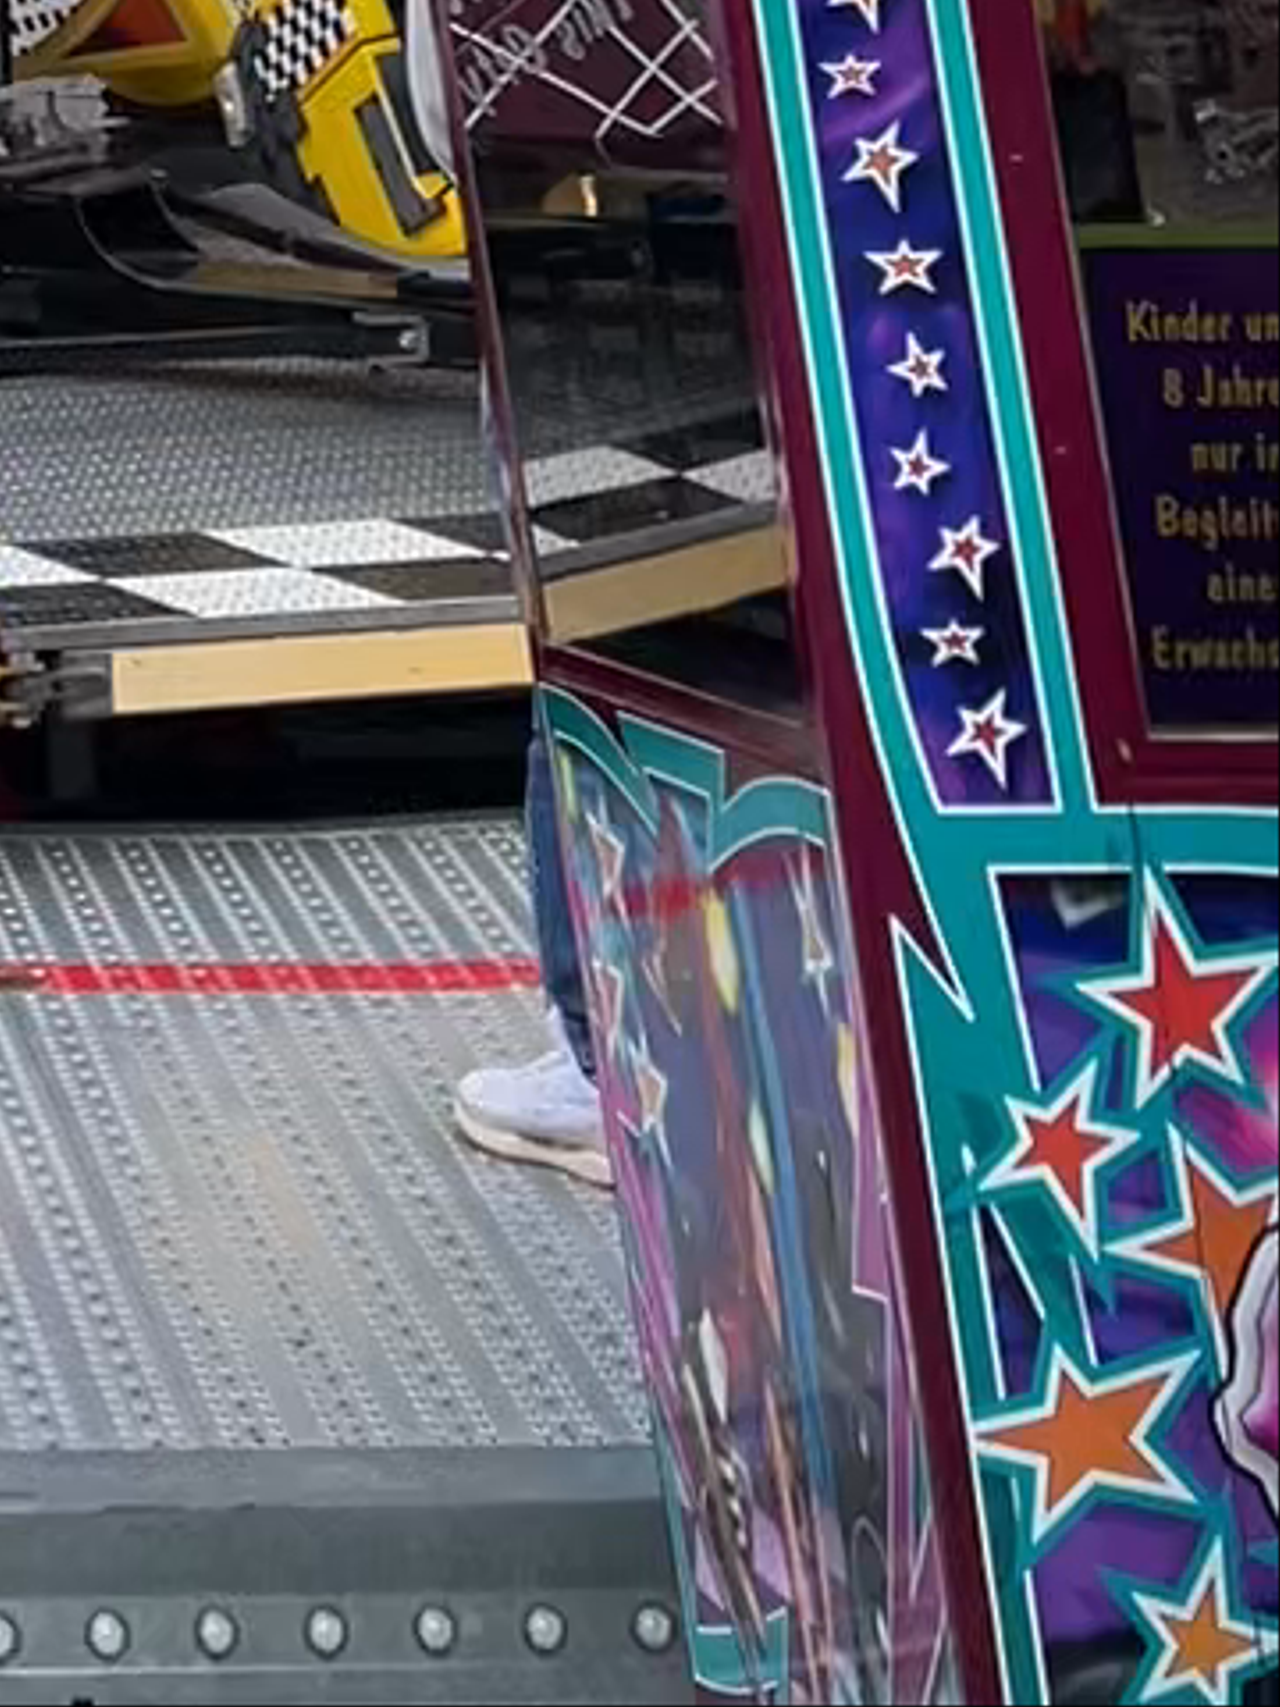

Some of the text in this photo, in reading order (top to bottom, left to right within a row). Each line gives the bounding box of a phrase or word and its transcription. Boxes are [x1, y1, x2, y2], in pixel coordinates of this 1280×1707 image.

[1126, 298, 1231, 343] Kinder
[1163, 367, 1184, 408] 8
[1192, 442, 1243, 472] nur
